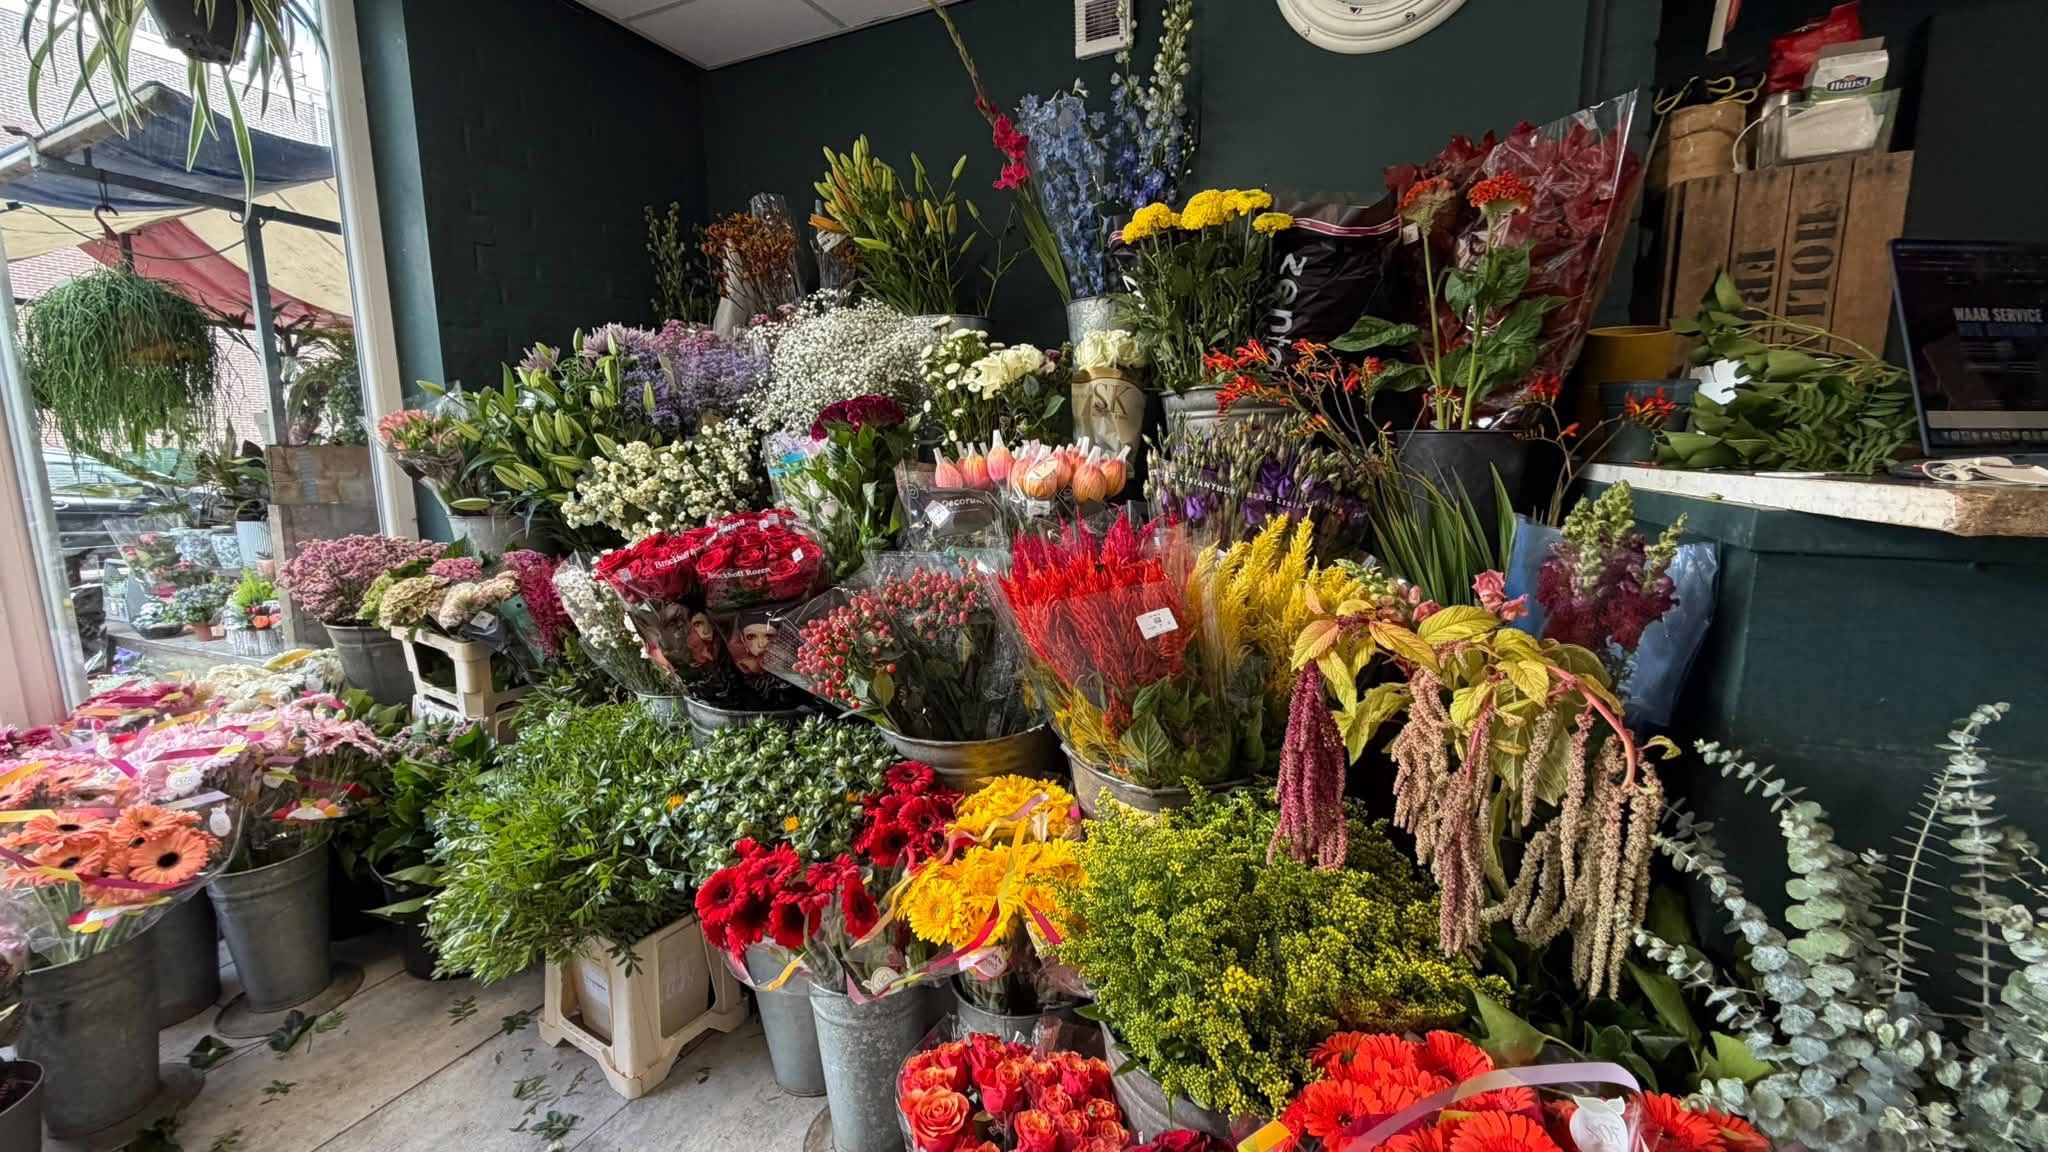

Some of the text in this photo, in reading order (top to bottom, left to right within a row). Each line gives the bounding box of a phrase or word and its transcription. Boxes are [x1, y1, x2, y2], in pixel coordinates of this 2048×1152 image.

[1953, 307, 2043, 322] WAAR SERVICE
[1093, 382, 1132, 416] SK
[654, 548, 690, 569] Brockhoff
[745, 567, 771, 577] Rozen
